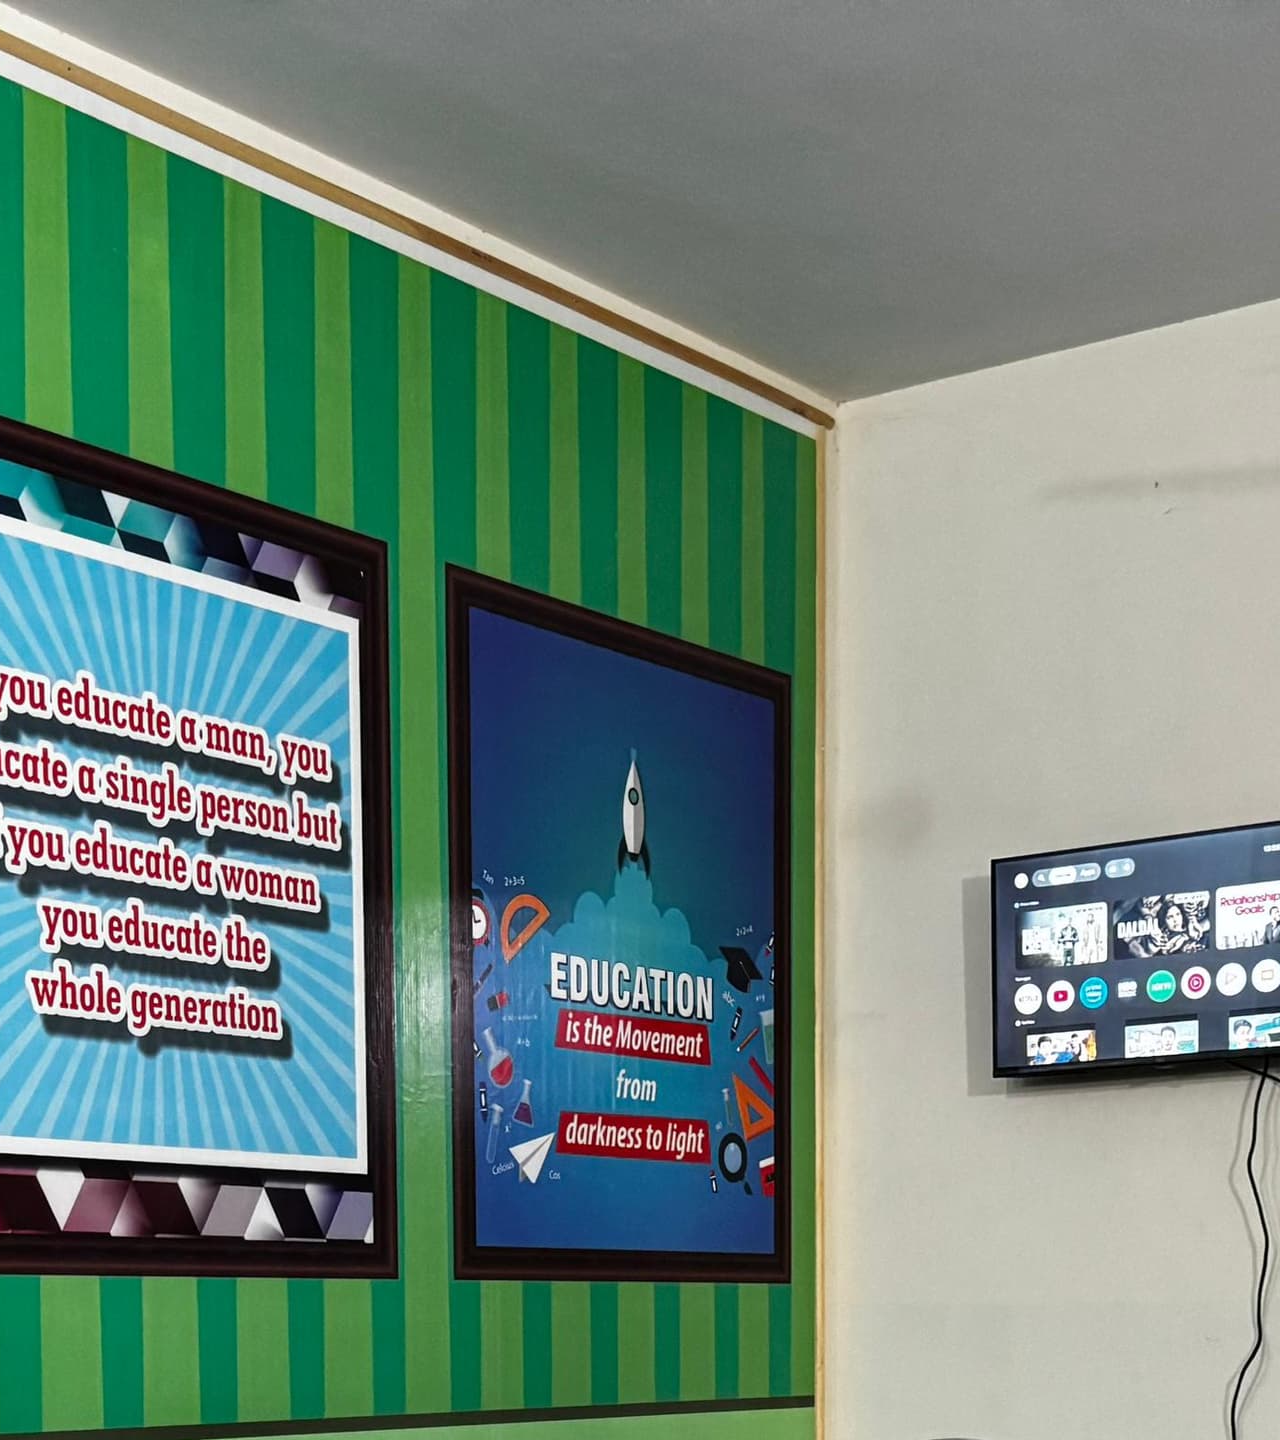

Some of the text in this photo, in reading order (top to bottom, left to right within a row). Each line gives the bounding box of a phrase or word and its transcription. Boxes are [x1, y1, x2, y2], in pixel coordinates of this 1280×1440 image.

[57, 678, 170, 739] educate
[180, 715, 197, 745] a
[206, 722, 275, 767] man,
[281, 738, 328, 777] you
[79, 765, 95, 795] a
[106, 768, 191, 819] single
[201, 789, 288, 834] person
[297, 796, 338, 844] but
[8, 826, 65, 866] you
[75, 827, 187, 883] educate
[197, 858, 212, 887] a
[221, 863, 316, 906] woman
[504, 876, 526, 887] 2+3=5
[1220, 892, 1280, 907] Relationship
[1235, 904, 1265, 916] Goals
[42, 903, 266, 964] you educate the
[31, 966, 278, 1034] whole generation
[550, 952, 714, 1021] EDUCATION
[565, 1013, 703, 1058] is the Movement
[616, 1069, 656, 1102] from
[565, 1114, 705, 1157] darkness to light
